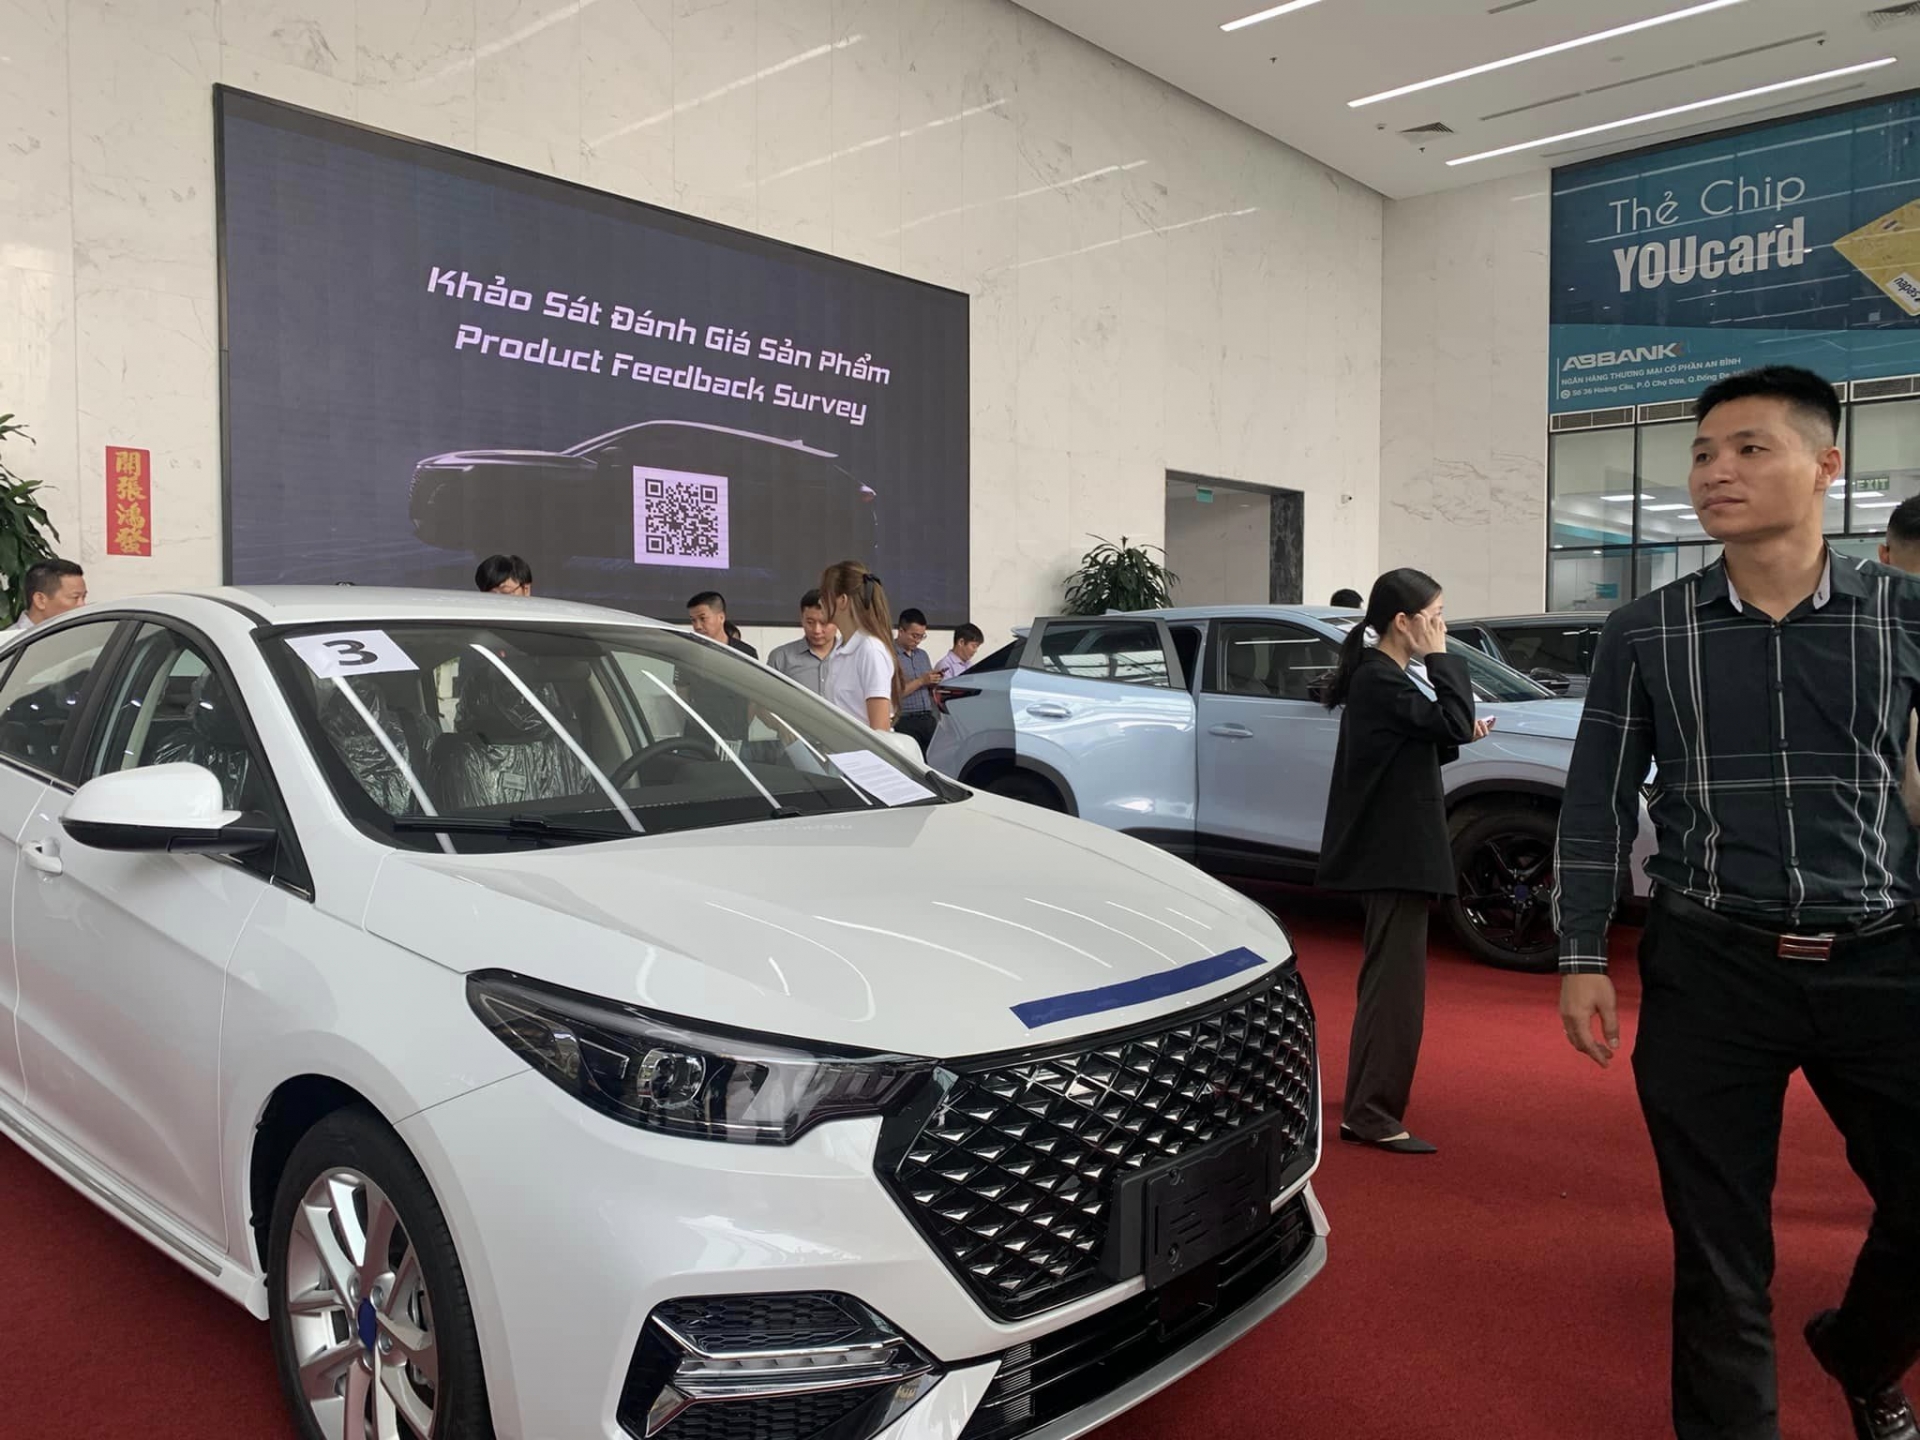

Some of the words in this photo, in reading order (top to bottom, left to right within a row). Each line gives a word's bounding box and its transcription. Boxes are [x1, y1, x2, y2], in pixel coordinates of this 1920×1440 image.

[1608, 190, 1680, 234] Thẻ
[1700, 176, 1806, 216] Chip
[1613, 216, 1805, 293] YOUcard
[427, 266, 533, 312] Khảo
[543, 291, 602, 326] Sát
[610, 304, 697, 345] Đánh
[705, 325, 751, 356] Giá
[758, 338, 812, 369] Sản
[818, 353, 890, 385] Phẩm
[455, 323, 604, 374] Product
[611, 352, 765, 403] Feedback
[773, 383, 867, 426] Survey
[1561, 343, 1677, 371] ABBANK
[1705, 360, 1717, 368] AN
[1857, 478, 1888, 491] EXIT
[322, 639, 378, 666] 3
